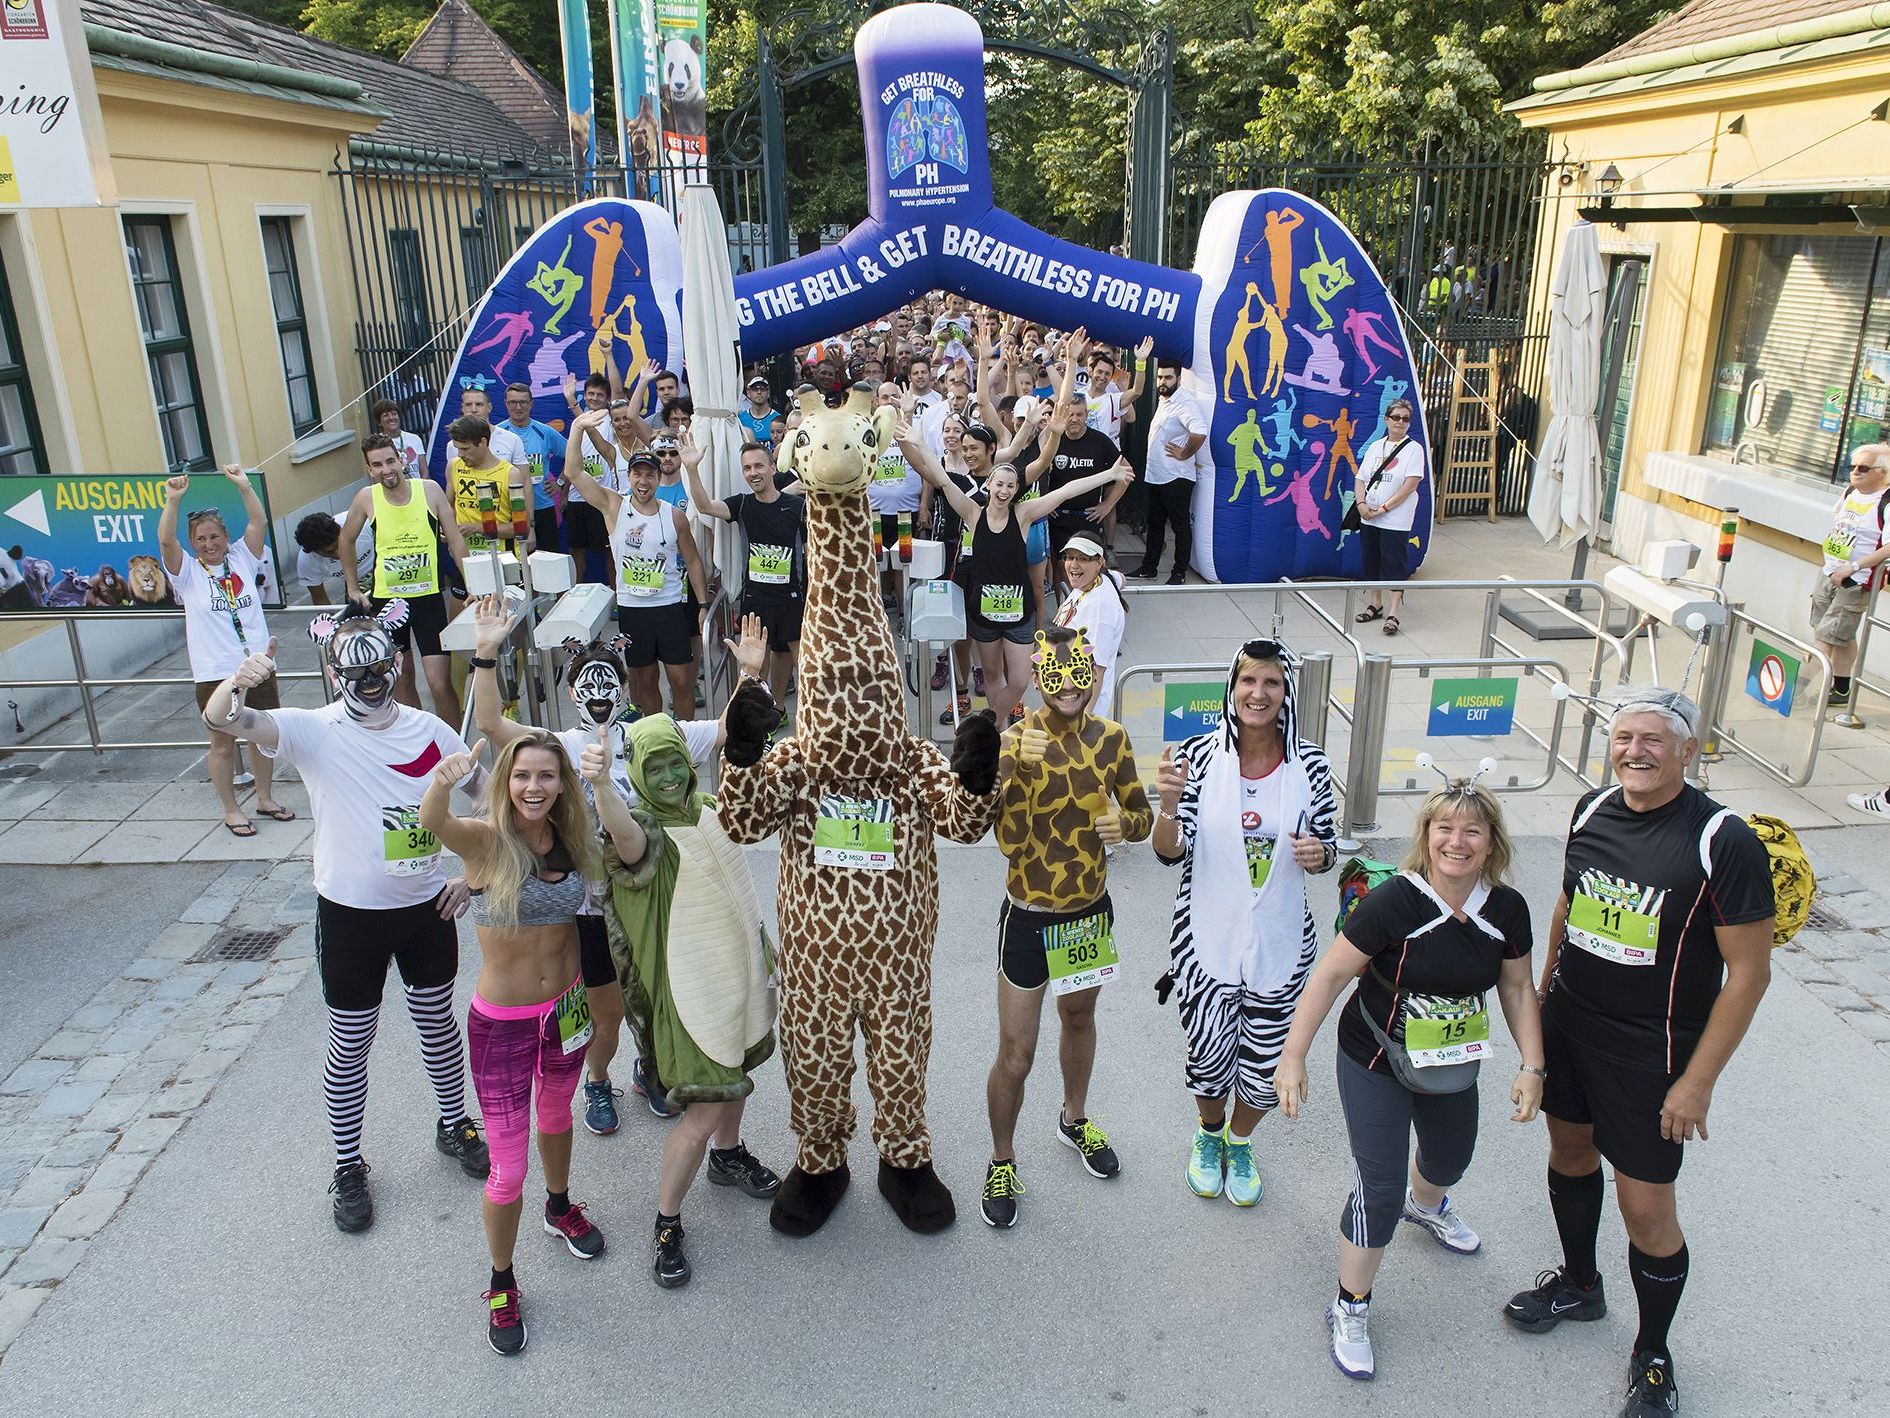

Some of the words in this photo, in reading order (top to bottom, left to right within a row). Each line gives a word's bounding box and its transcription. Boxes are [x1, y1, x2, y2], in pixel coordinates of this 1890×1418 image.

[881, 83, 898, 105] GET
[898, 72, 964, 99] BREATHLESS
[913, 87, 935, 102] FOR
[915, 163, 939, 185] PH
[889, 188, 924, 198] PULMONARY
[926, 184, 969, 196] HYPERTENSION
[753, 282, 804, 320] THE
[801, 265, 862, 307] BELL
[857, 255, 887, 284] &
[880, 225, 928, 269] GET
[942, 224, 1092, 298] BREATHLESS
[1092, 274, 1143, 313] FOR
[1141, 287, 1181, 322] PH
[1069, 457, 1094, 469] XLETIX
[884, 467, 895, 475] 63
[93, 514, 144, 543] EXIT
[760, 559, 779, 569] 447
[398, 569, 418, 580] 297
[632, 572, 651, 582] 321
[993, 599, 1012, 608] 218
[1189, 700, 1223, 713] AUSGA
[1455, 695, 1504, 707] AUSGANG
[1467, 709, 1489, 720] EXIT
[851, 823, 860, 840] 1
[408, 830, 436, 849] 340
[1601, 907, 1621, 930] 11
[1596, 926, 1621, 939] JOHANNES
[1067, 943, 1098, 965] 503
[1601, 943, 1616, 953] MSD
[1626, 949, 1642, 957] BIPA
[1083, 973, 1096, 982] MSD
[1442, 1021, 1466, 1040] 15
[1467, 1044, 1481, 1052] BIPA
